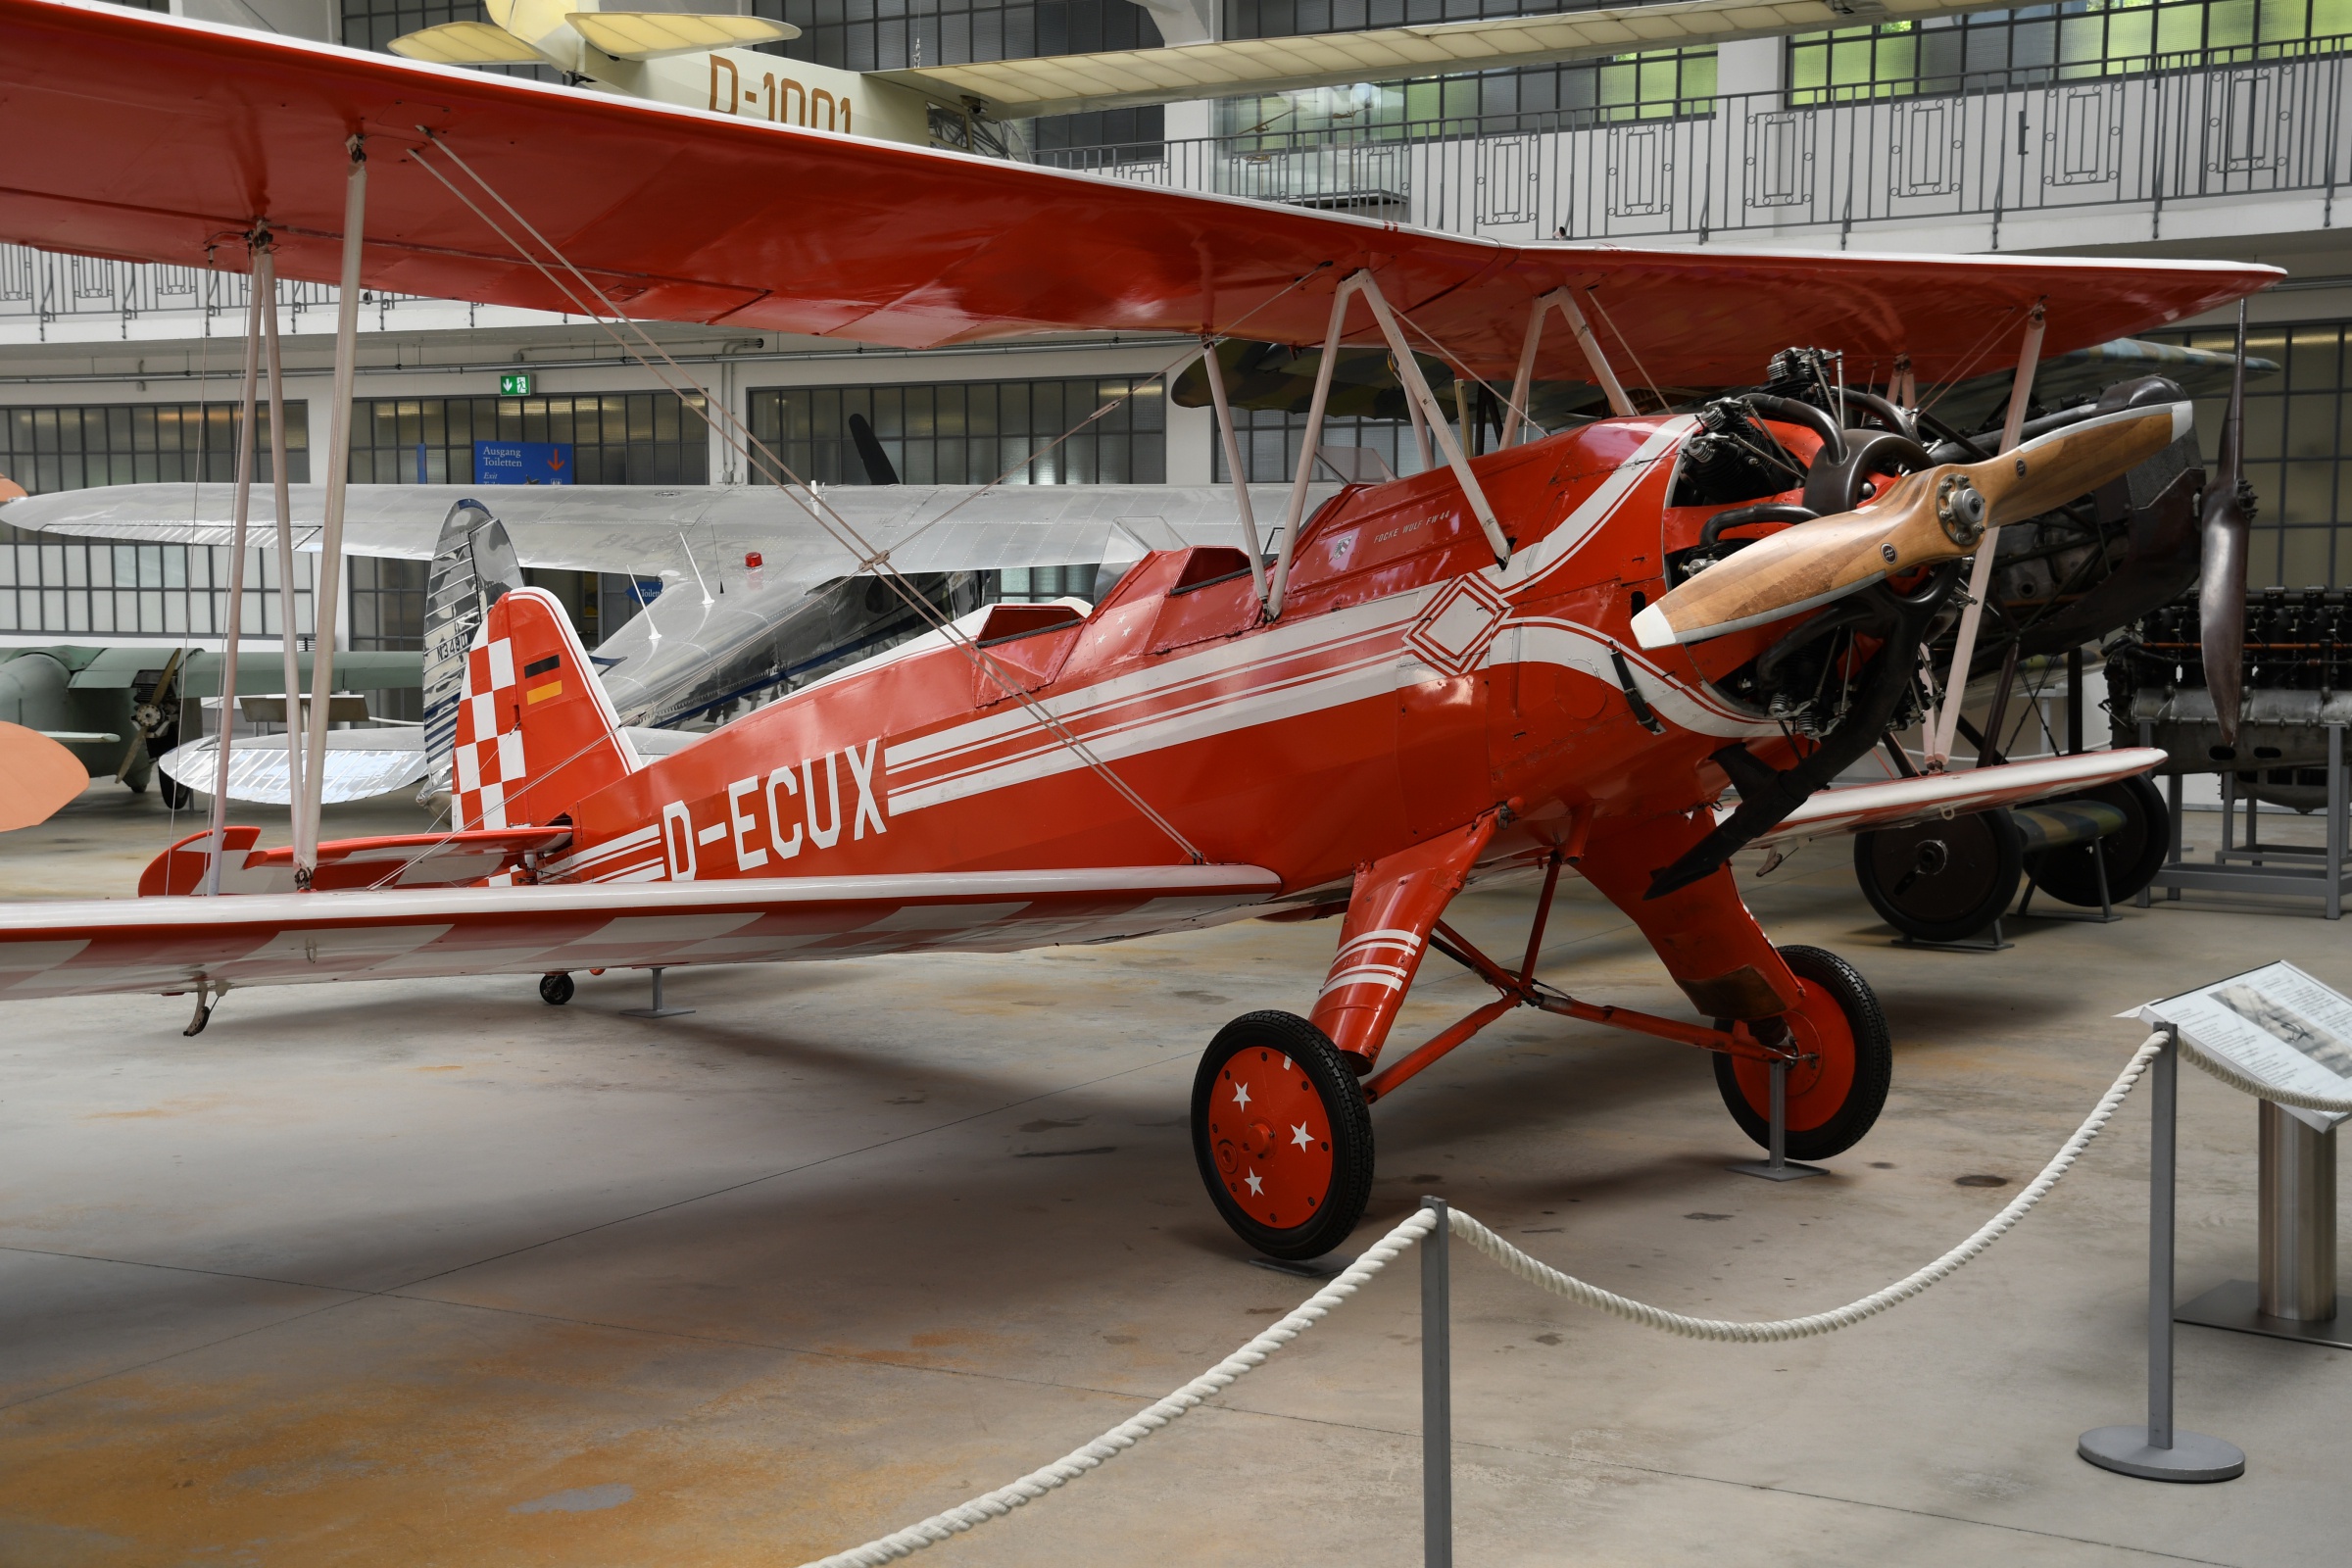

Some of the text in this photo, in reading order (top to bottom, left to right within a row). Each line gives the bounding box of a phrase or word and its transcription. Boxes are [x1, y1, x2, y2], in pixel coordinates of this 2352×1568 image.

[710, 54, 852, 134] D-1001
[483, 446, 521, 458] Ausgang
[483, 457, 522, 467] Toiletten
[1374, 527, 1399, 544] FOCKE
[1401, 519, 1423, 534] WULF
[662, 738, 888, 881] D-ECUX
